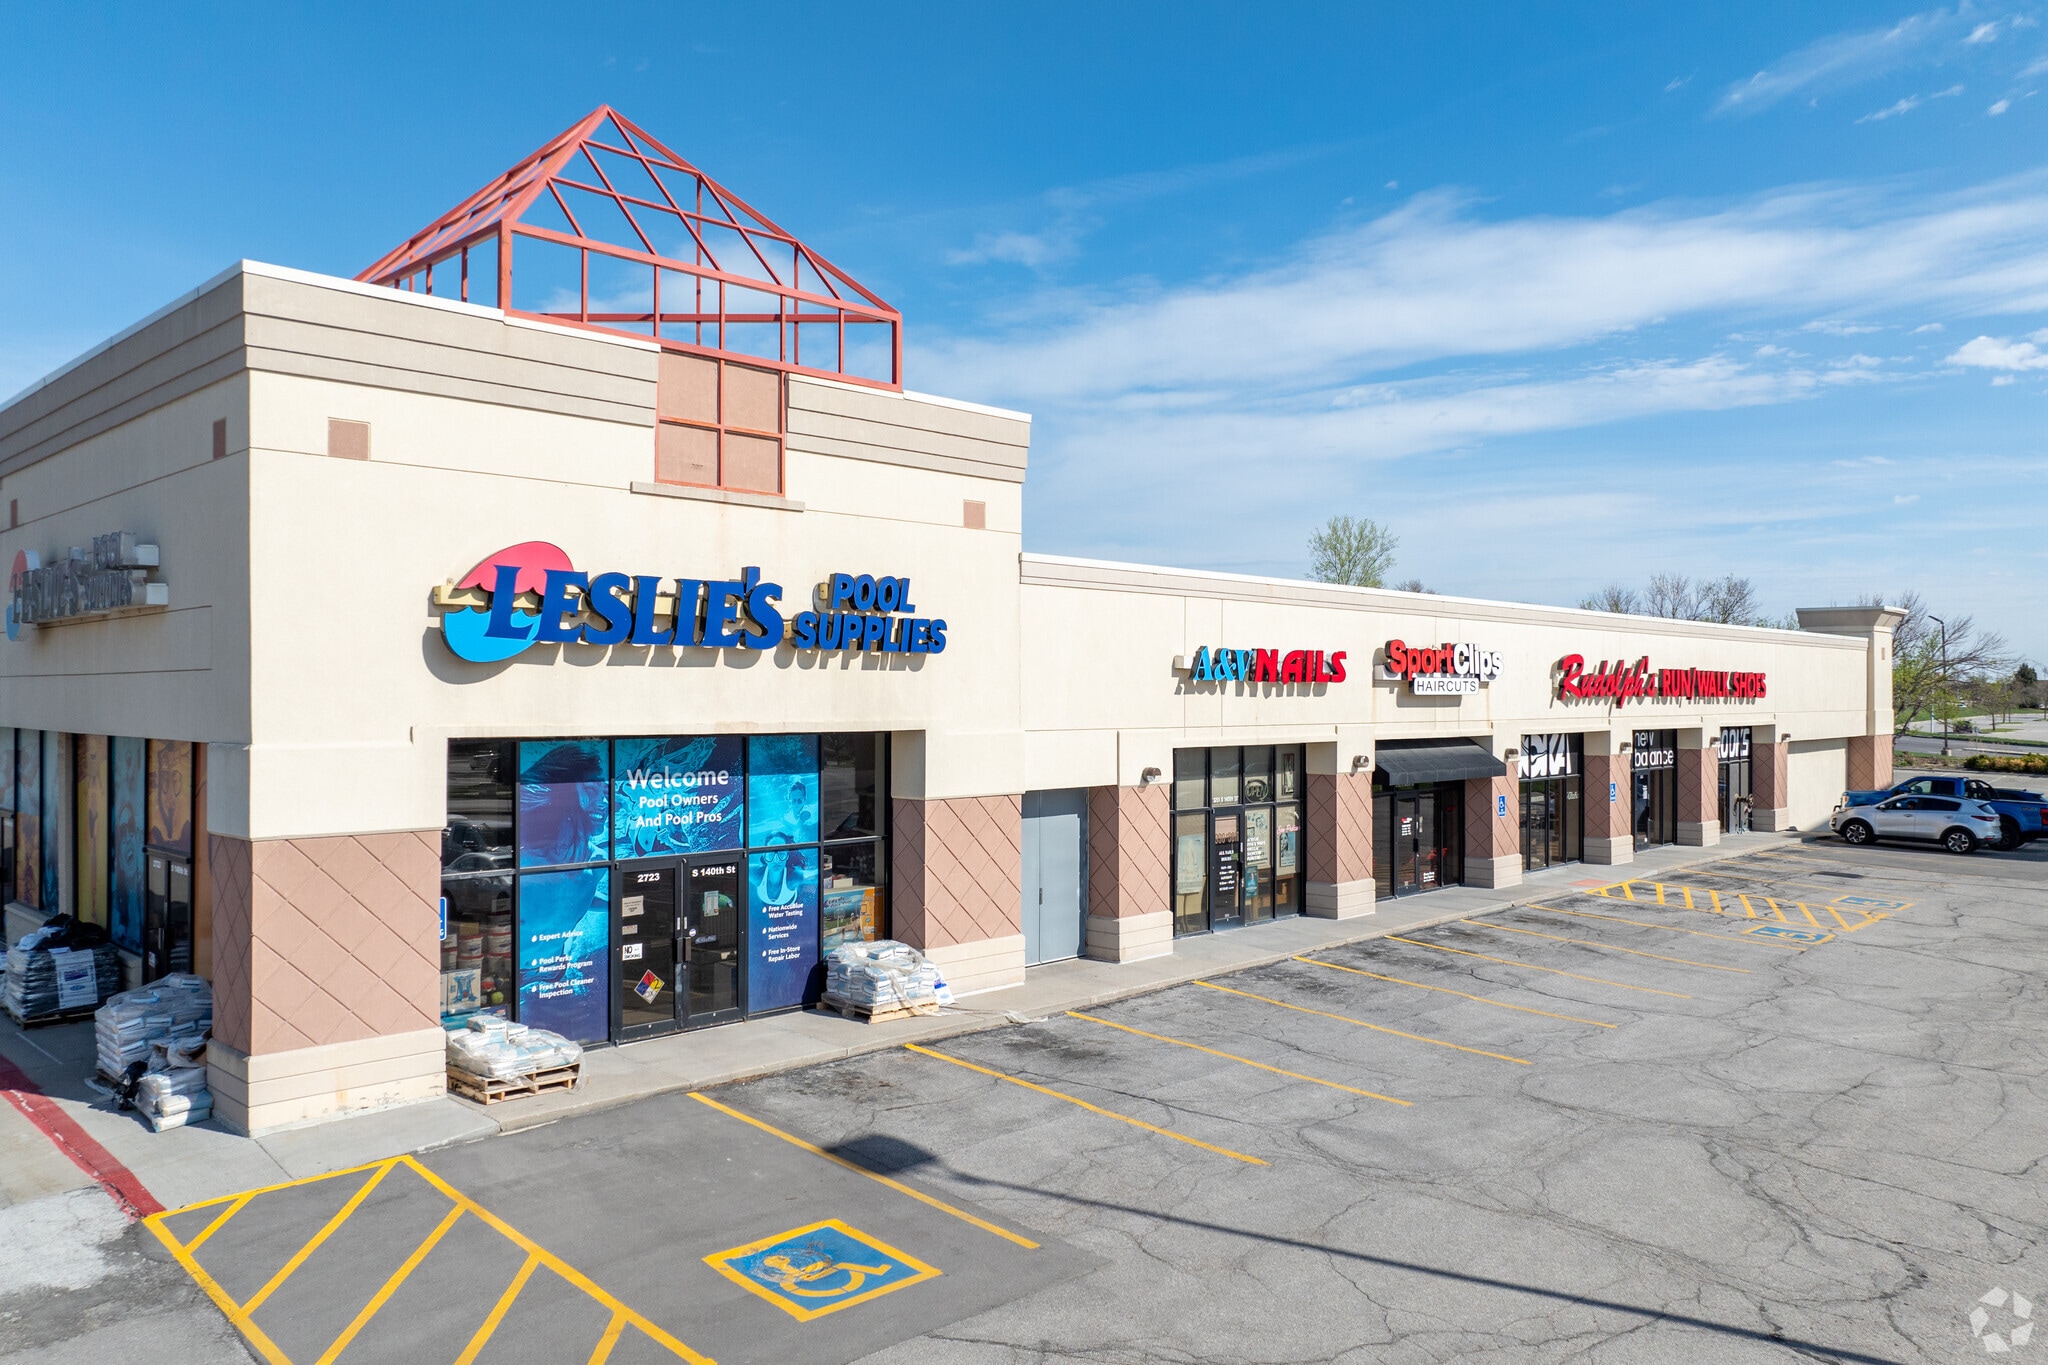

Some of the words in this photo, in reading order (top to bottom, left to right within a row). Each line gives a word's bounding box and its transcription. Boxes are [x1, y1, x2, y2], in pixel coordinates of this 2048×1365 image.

[831, 572, 916, 614] POOL
[484, 564, 783, 649] LESLIE'S
[794, 612, 947, 654] SUPPLIES
[1192, 645, 1253, 681] A&V
[1254, 648, 1347, 685] NAILS
[1416, 680, 1477, 692] HAIRCUTS
[1561, 653, 1656, 709] Rudolph's
[1732, 671, 1766, 699] SHOES
[1634, 748, 1675, 767] baance
[626, 765, 729, 790] Welcome
[639, 793, 668, 809] Pool
[671, 794, 719, 807] Owners
[635, 812, 662, 828] And
[665, 811, 693, 826] Pool
[696, 811, 722, 824] Pros
[637, 873, 660, 883] 2723
[691, 869, 699, 877] S
[700, 866, 724, 877] 140th
[726, 865, 736, 874] St
[768, 924, 797, 932] Nationwide
[539, 932, 560, 942] Expert
[561, 930, 584, 938] Advice
[624, 946, 633, 954] NO
[539, 956, 554, 964] Pool
[555, 954, 573, 962] Perks
[539, 963, 566, 973] Rewards
[566, 960, 593, 971] Program
[539, 982, 554, 991] Free
[554, 980, 569, 988] Pool
[570, 977, 595, 986] Cleaner
[539, 988, 573, 999] Inspection
